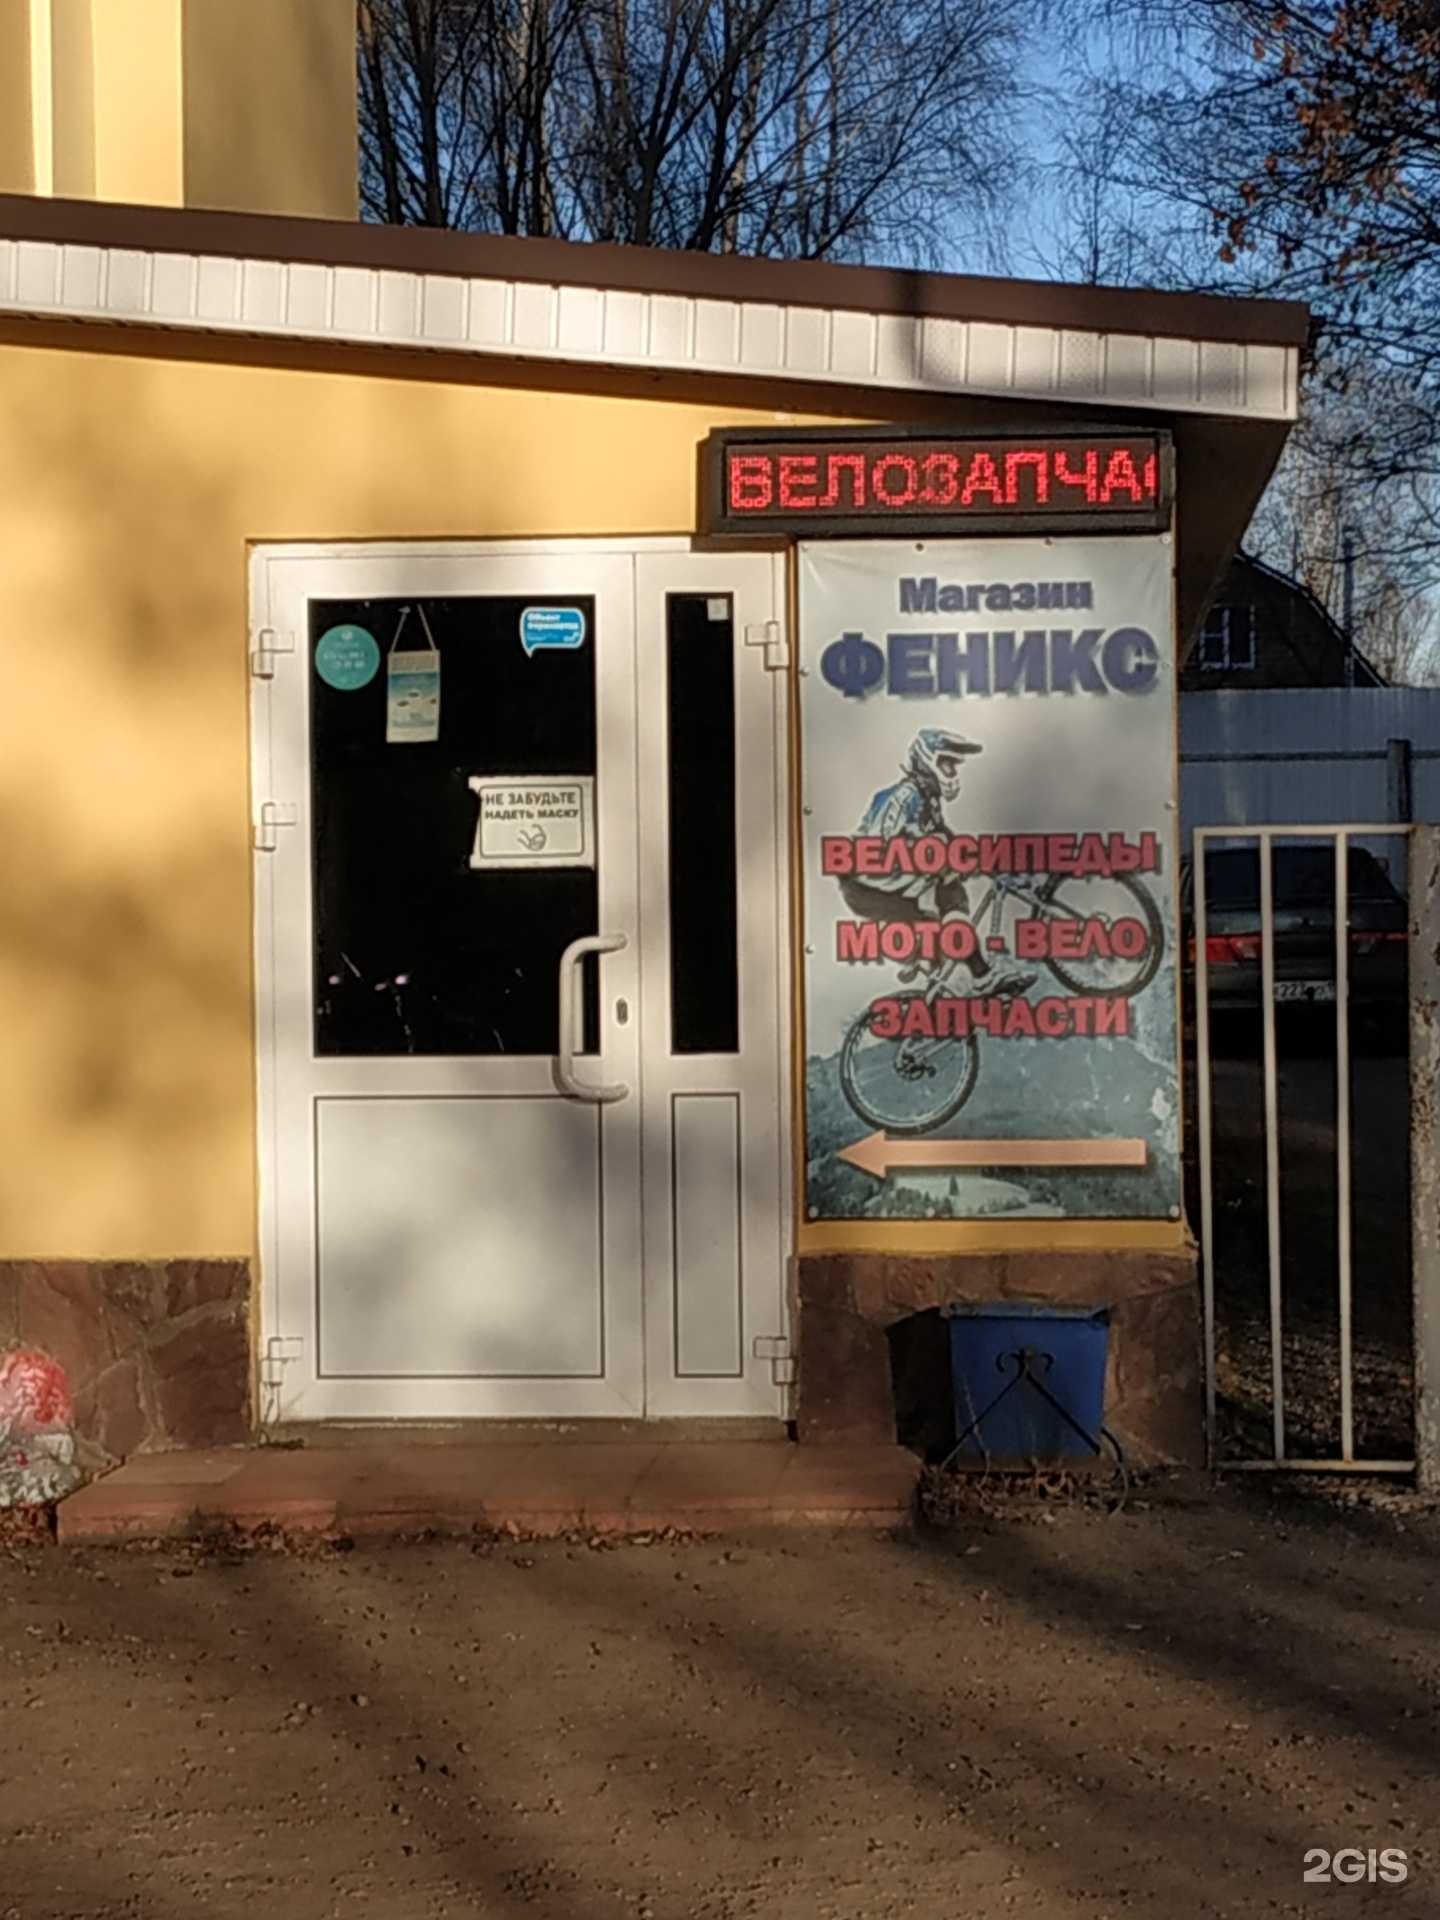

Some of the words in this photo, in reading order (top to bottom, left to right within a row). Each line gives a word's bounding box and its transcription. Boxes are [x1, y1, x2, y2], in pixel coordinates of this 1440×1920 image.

[731, 450, 1157, 508] ВЕЛОЗАПЧА
[899, 577, 1093, 614] Магазин
[820, 627, 1159, 699] ФЕНИКС
[485, 792, 504, 805] НЕ
[508, 791, 576, 806] ЗАБУДЬТЕ
[485, 809, 534, 820] НАДЕТЬ
[537, 808, 579, 819] МАСКУ
[821, 832, 1158, 877] ВЕЛОСИПЕДЫ
[836, 918, 978, 962] МОТО
[1014, 916, 1148, 959] ВЕЛО
[869, 995, 1131, 1040] ЗАПЧАСТИ
